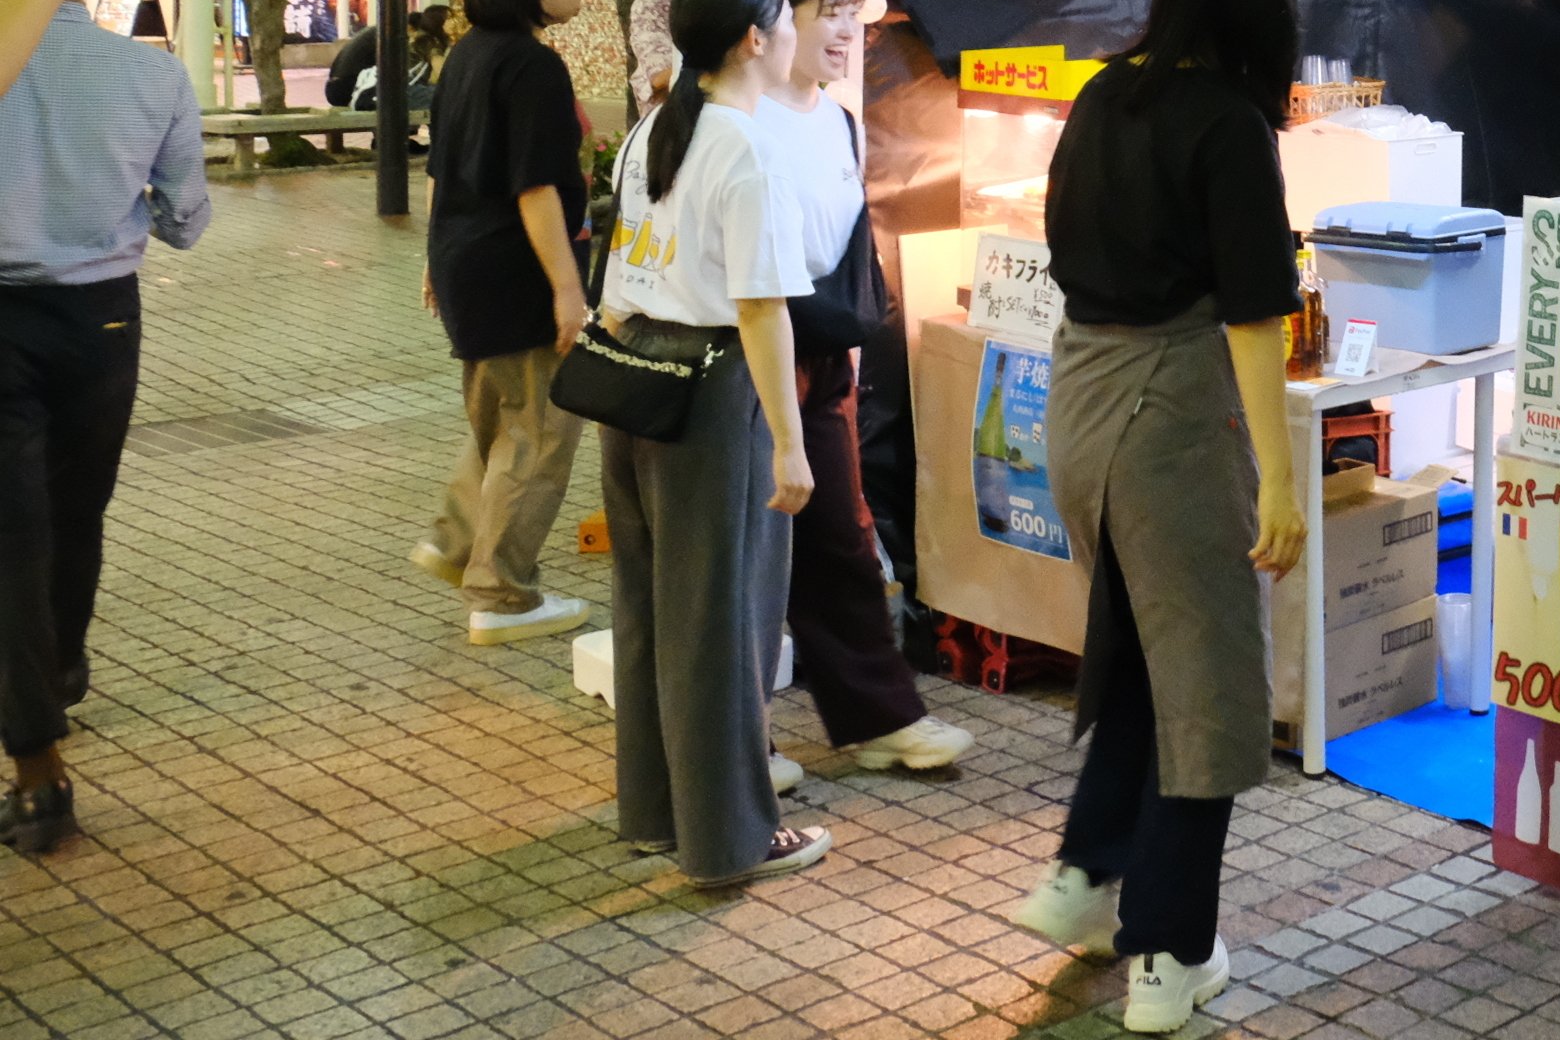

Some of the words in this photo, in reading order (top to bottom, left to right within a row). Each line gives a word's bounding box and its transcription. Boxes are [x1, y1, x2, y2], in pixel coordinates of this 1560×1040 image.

[973, 61, 1049, 91] ホットサービス
[1524, 267, 1560, 399] EVERY
[1015, 356, 1050, 390] 芋焼
[1010, 509, 1063, 544] 600円
[1135, 974, 1162, 987] FILA
